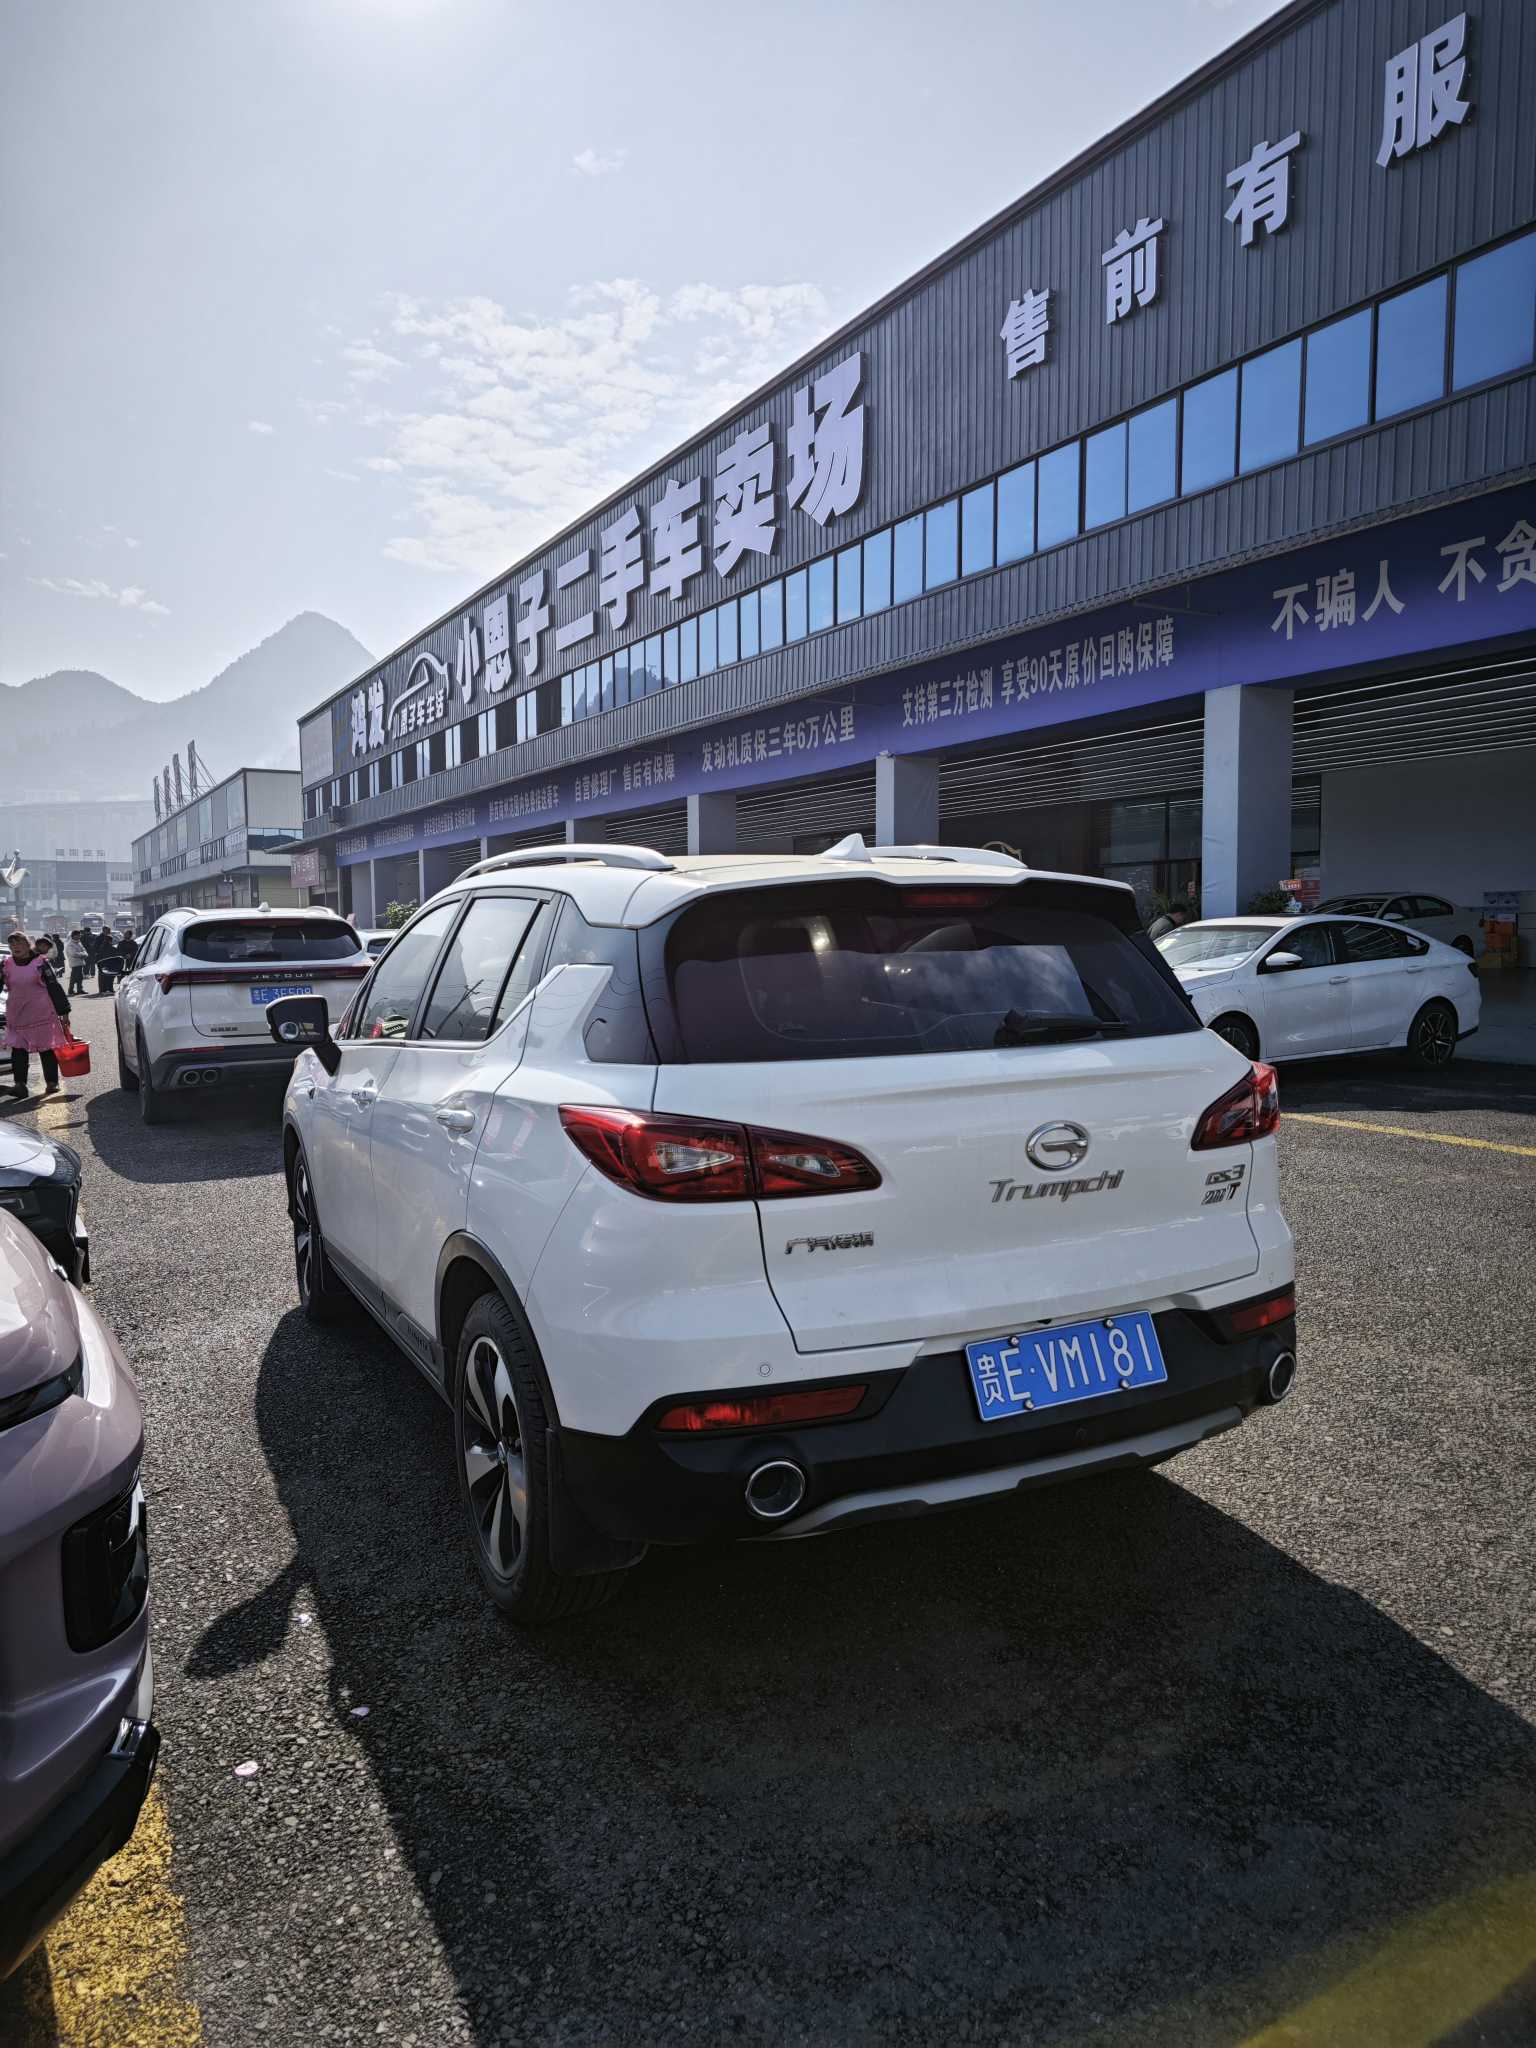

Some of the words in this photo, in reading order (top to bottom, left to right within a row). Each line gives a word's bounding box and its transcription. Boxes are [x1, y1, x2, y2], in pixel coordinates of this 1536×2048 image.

[1270, 560, 1405, 640] 不骗人
[902, 667, 993, 728] 支持第三方检测
[1000, 615, 1175, 705] 享受90天原价回购保障
[701, 706, 856, 773] 发动机质保三年6万公里
[574, 769, 617, 803] 自营修理厂
[623, 753, 676, 792] 售后有保障
[989, 1170, 1124, 1203] Trumpchi
[1205, 1164, 1246, 1186] GS3
[784, 1231, 874, 1255] 广汽传祺
